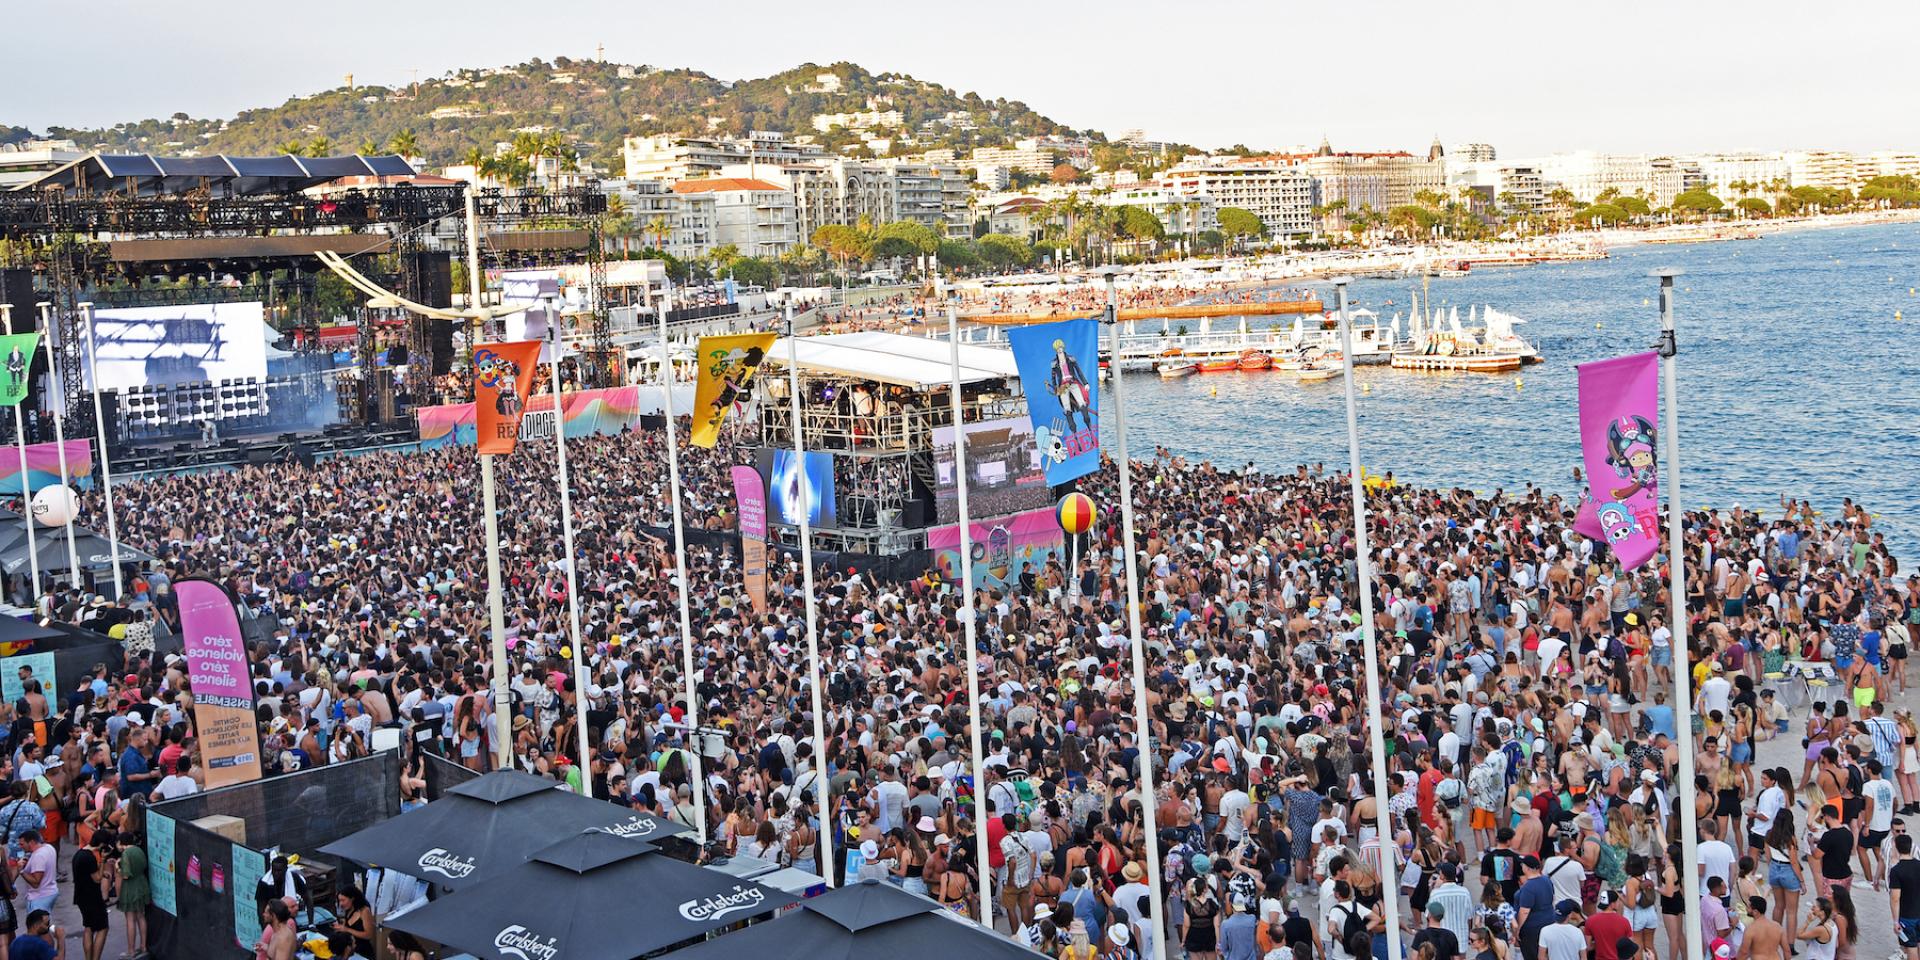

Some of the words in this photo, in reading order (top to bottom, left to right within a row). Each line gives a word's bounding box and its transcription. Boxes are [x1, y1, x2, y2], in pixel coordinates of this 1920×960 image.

[604, 816, 657, 837] lsberg
[418, 847, 476, 879] Carlsberg
[678, 885, 765, 921] Carlsberg
[494, 924, 558, 960] Carlsberg
